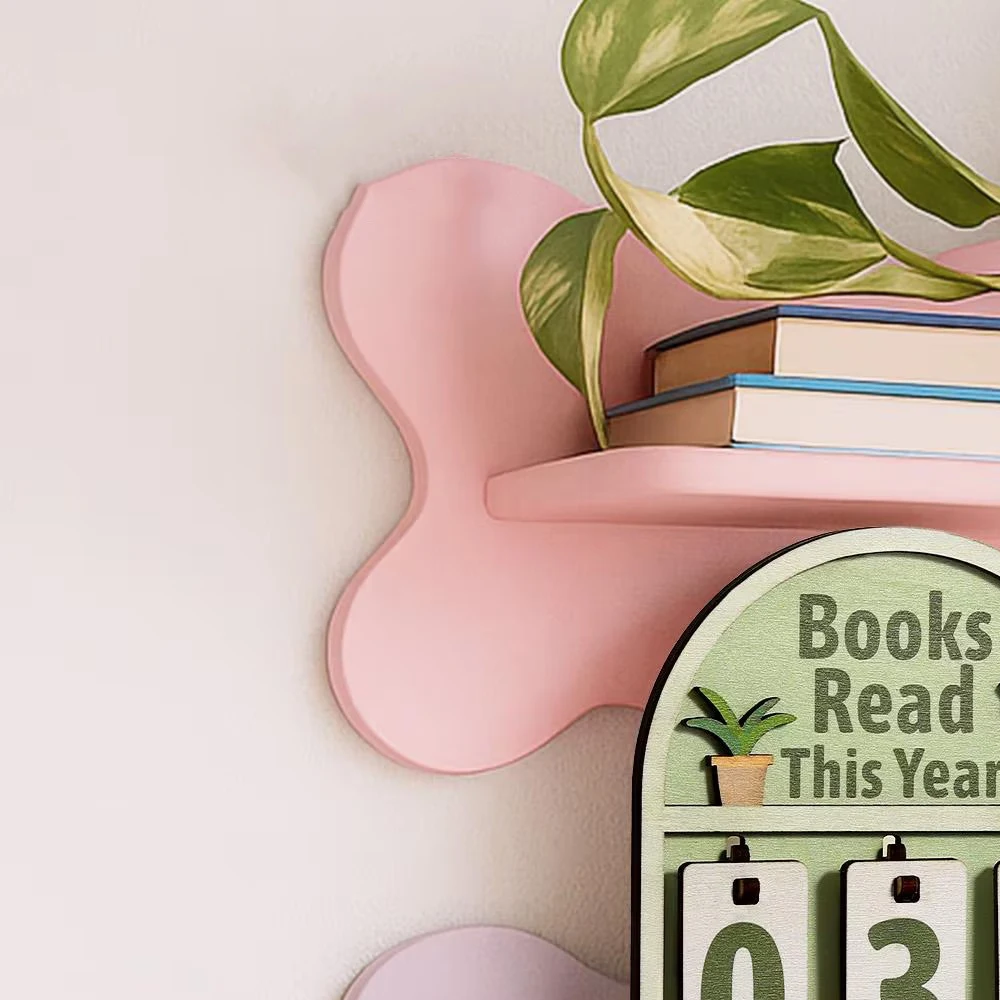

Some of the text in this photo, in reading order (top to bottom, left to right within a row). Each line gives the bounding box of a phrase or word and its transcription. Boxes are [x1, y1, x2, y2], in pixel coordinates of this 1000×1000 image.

[799, 590, 993, 661] Books
[813, 664, 974, 735] Read
[780, 744, 883, 799] This
